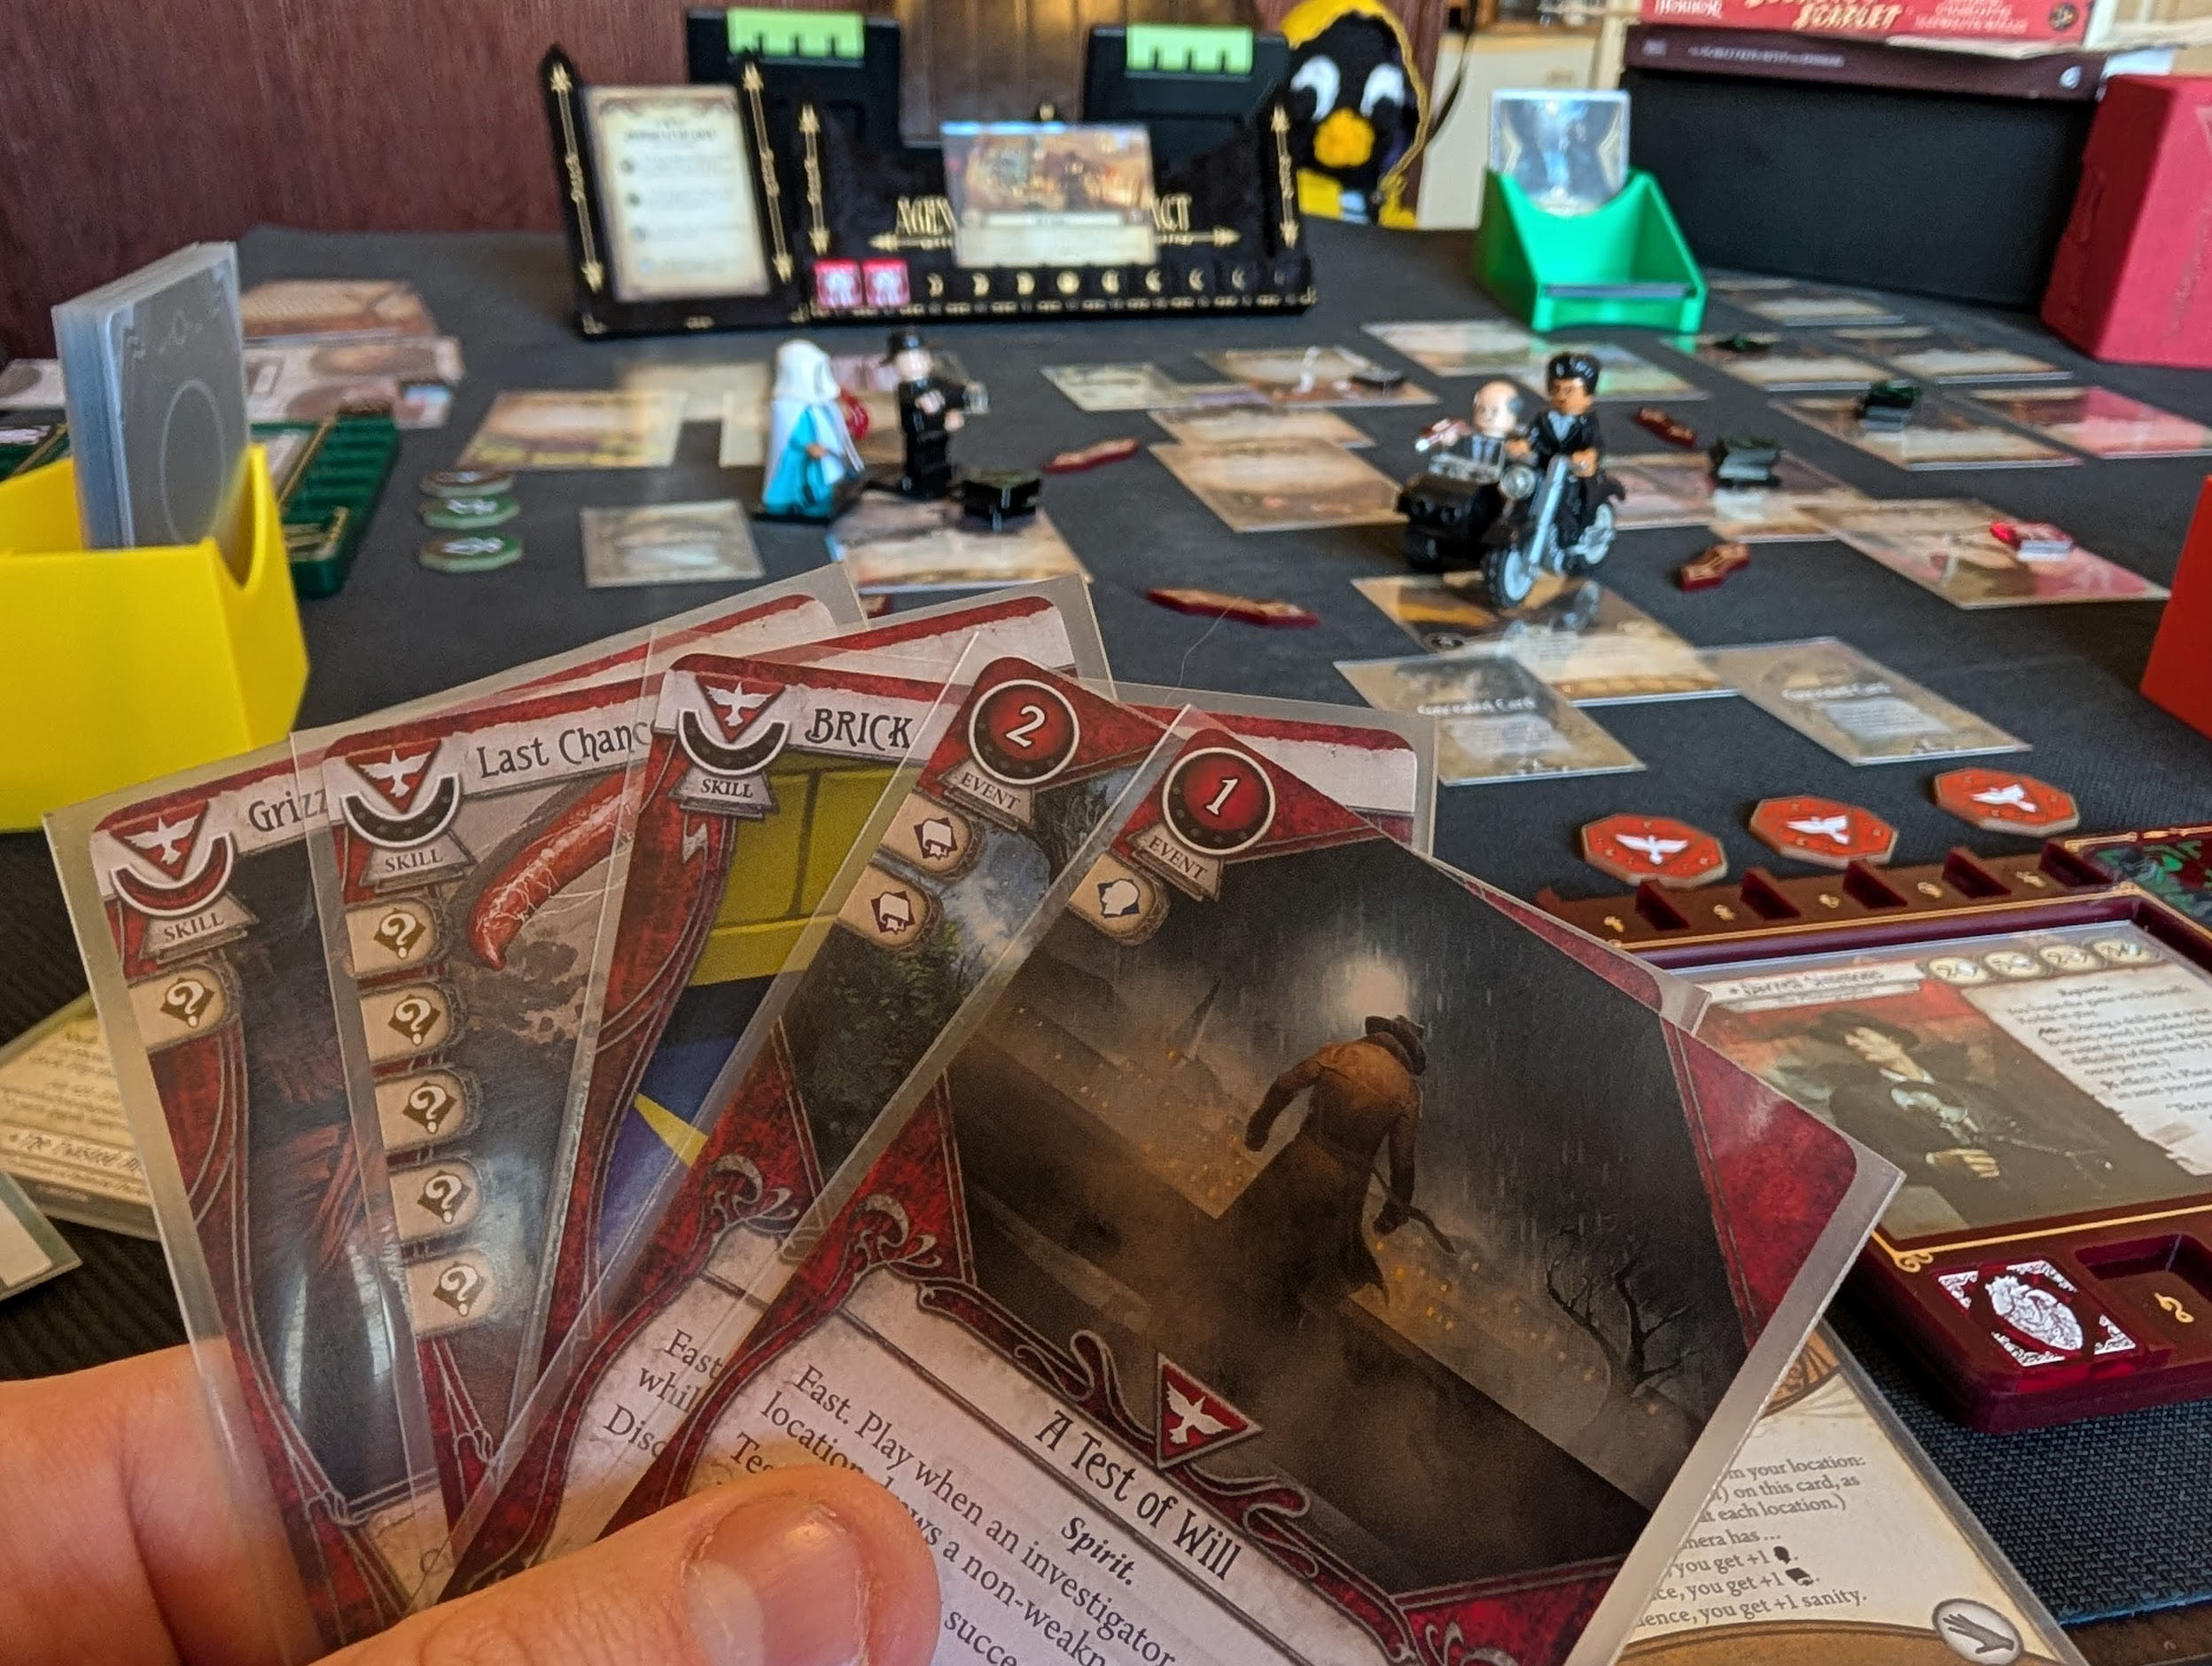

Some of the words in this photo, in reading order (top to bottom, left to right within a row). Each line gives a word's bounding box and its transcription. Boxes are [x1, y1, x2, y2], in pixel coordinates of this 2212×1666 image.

[804, 708, 913, 751] BRICK
[1004, 705, 1046, 748] 2
[477, 736, 549, 779] Last
[558, 719, 656, 765] Chanc
[699, 777, 752, 798] SKILL
[961, 771, 1021, 812] EVENT
[1205, 777, 1239, 816] 1
[248, 789, 329, 832] Grizz
[384, 848, 445, 873] SKILL
[1151, 835, 1209, 879] EVENT
[164, 912, 224, 942] SKILL
[637, 1366, 701, 1414] whil
[1733, 1486, 1759, 1499] on
[1759, 1480, 1793, 1496] this
[1796, 1475, 1841, 1492] card,
[1842, 1476, 1860, 1489] as
[1747, 1464, 1787, 1482] your
[1787, 1455, 1866, 1474] location:
[1034, 1409, 1073, 1452] A
[1071, 1432, 1135, 1502] Test
[1137, 1491, 1179, 1529] of
[1172, 1508, 1242, 1581] Will
[1717, 1503, 1759, 1522] each
[1758, 1492, 1847, 1516] location.)
[793, 1364, 850, 1425] Fast.
[854, 1411, 913, 1471] Play
[915, 1468, 984, 1526] when
[985, 1520, 1019, 1553] an
[1020, 1540, 1175, 1666] investigator
[942, 1540, 961, 1562] a
[1062, 1516, 1135, 1585] Spirit.
[1725, 1529, 1760, 1544] has
[1674, 1558, 1711, 1578] you
[1714, 1554, 1744, 1575] get
[1747, 1550, 1771, 1568] +1
[1686, 1583, 1724, 1601] you
[1727, 1576, 1756, 1597] get
[1759, 1572, 1783, 1589] +1
[1697, 1605, 1737, 1624] you
[1741, 1600, 1770, 1620] get
[1773, 1594, 1798, 1612] +1
[1802, 1589, 1867, 1608] sanity.
